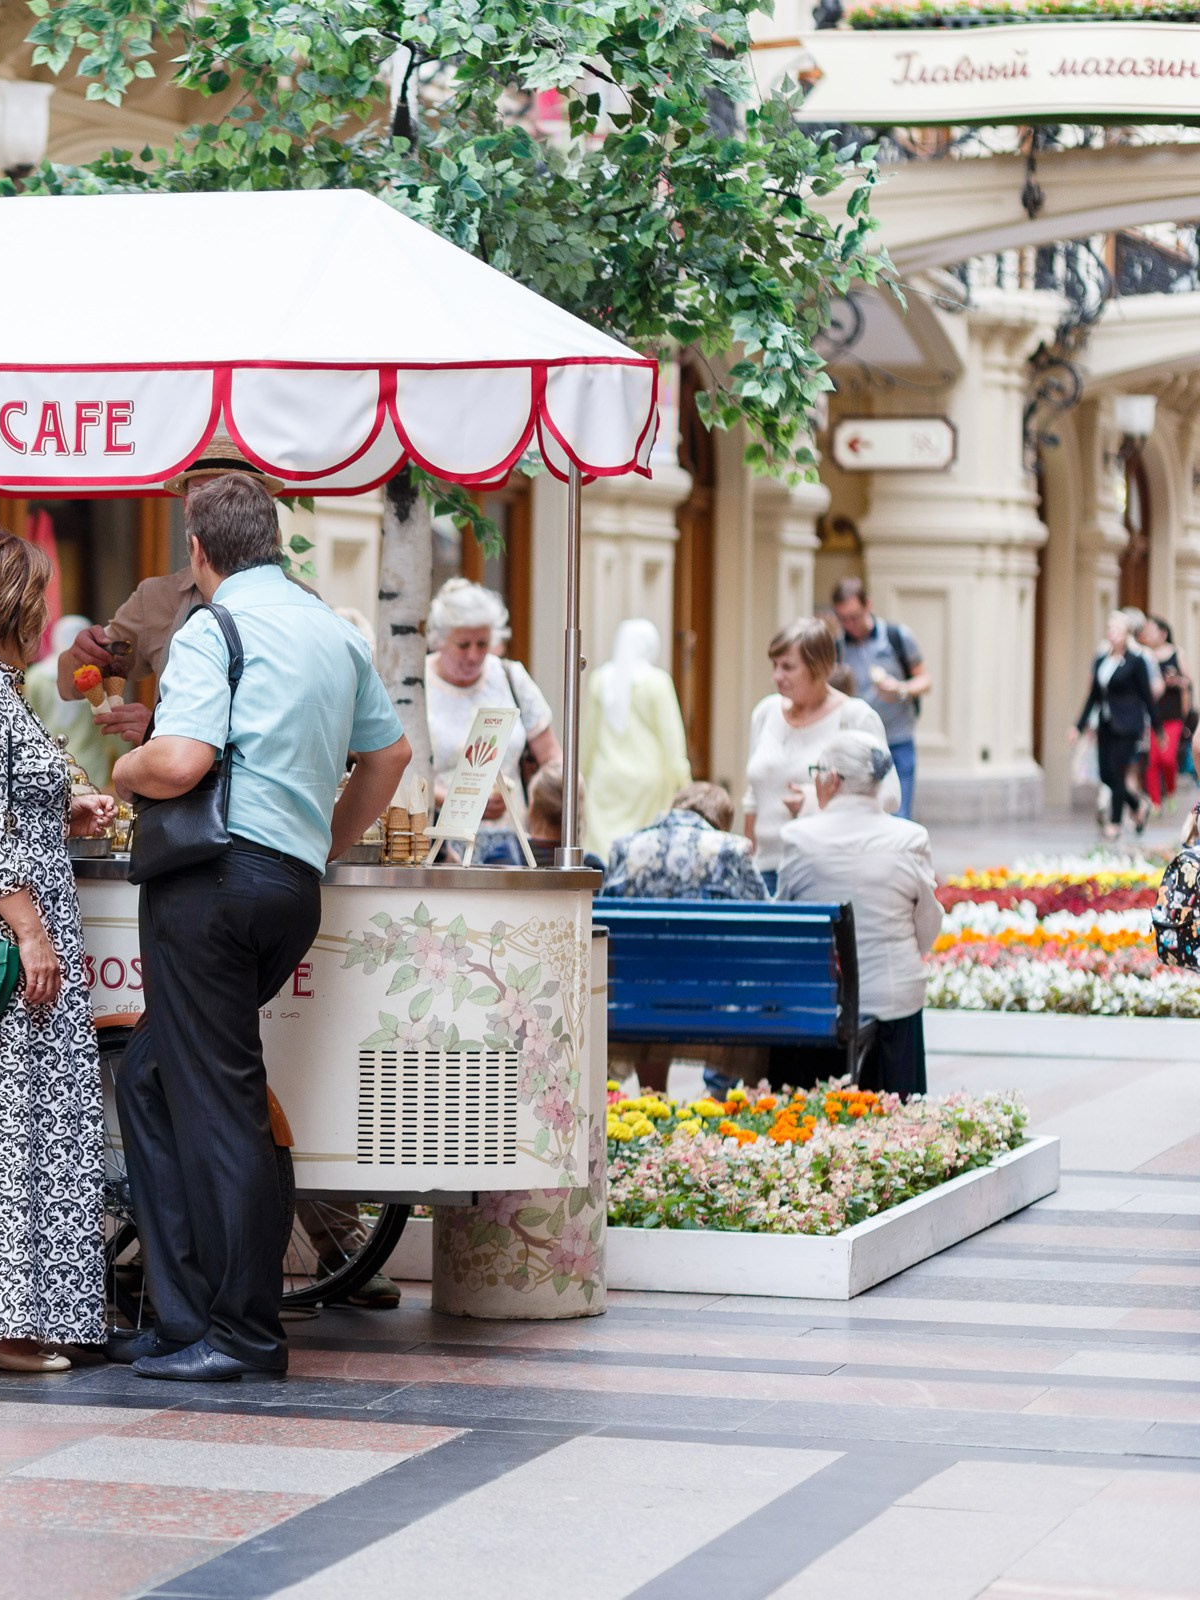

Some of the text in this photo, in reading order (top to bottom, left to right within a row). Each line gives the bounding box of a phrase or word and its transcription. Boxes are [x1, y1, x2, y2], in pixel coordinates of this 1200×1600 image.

[892, 48, 1200, 87] Главный магазин
[115, 1001, 141, 1014] cafe
